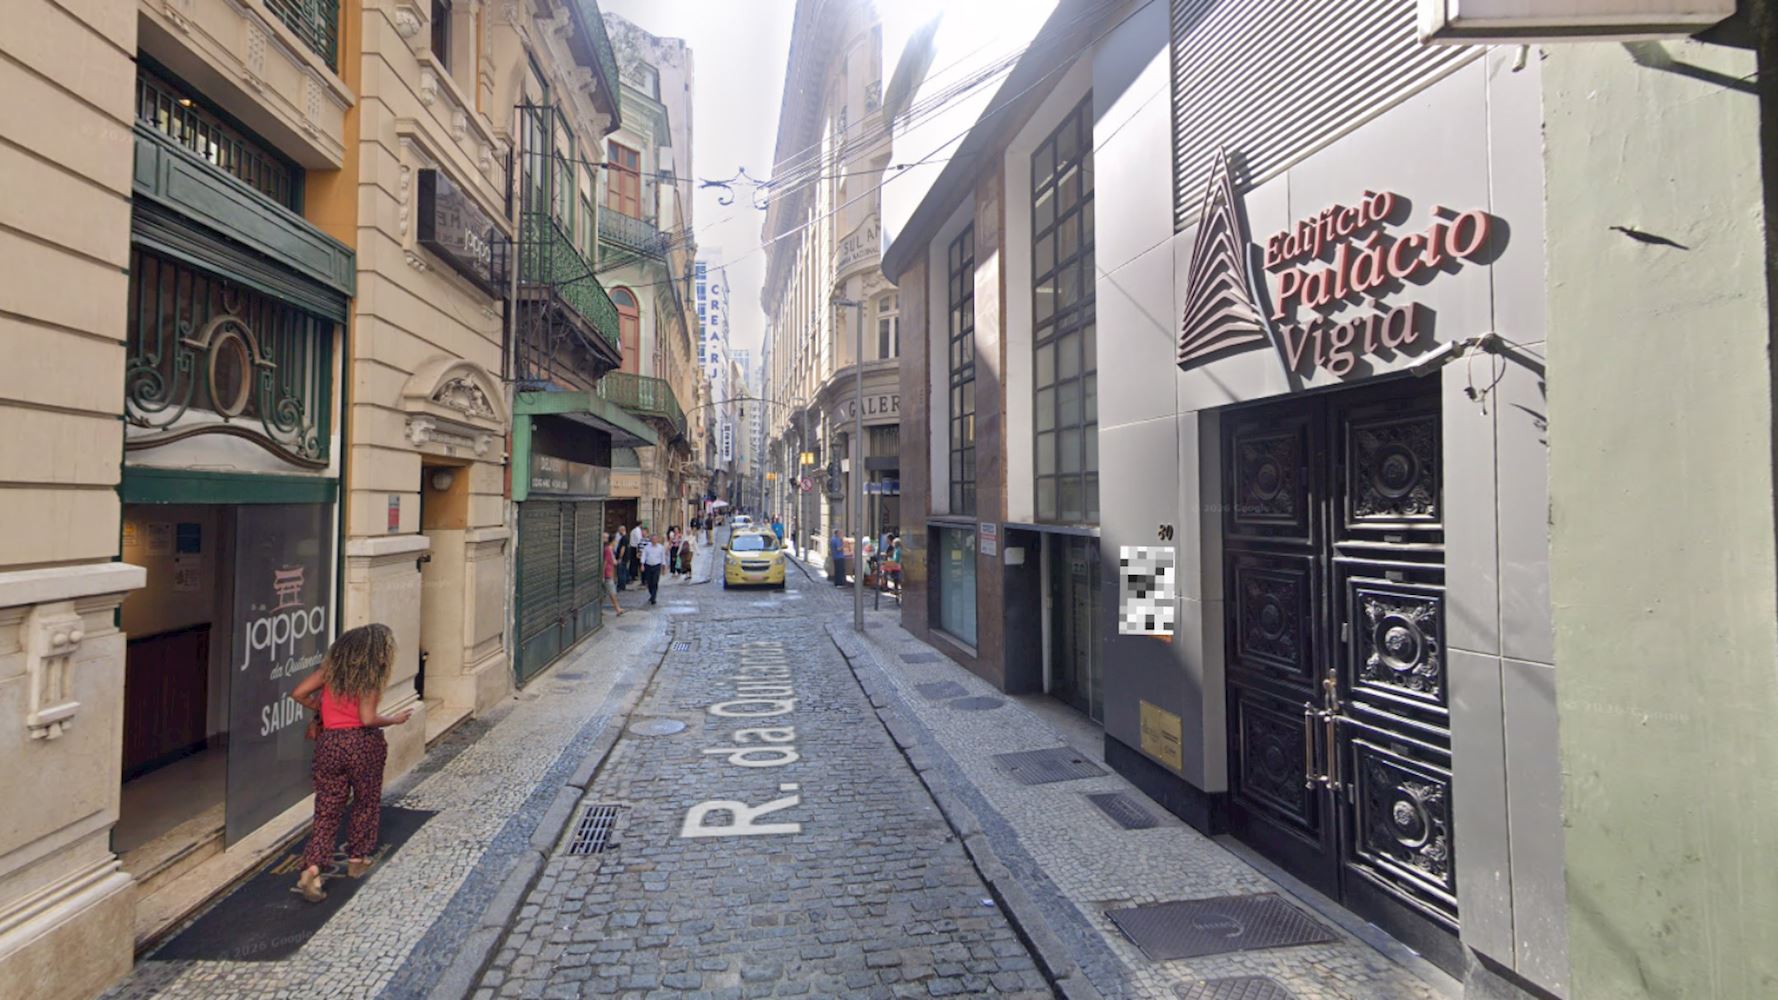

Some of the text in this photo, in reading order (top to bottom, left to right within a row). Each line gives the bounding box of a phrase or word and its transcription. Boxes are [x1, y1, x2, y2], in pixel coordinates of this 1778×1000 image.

[843, 235, 864, 256] SUL
[1263, 190, 1394, 270] Edifício
[1271, 205, 1490, 321] Palácio
[710, 284, 719, 378] CREA-RJ
[1279, 299, 1419, 376] Vigia
[240, 605, 325, 671] jappa
[285, 651, 322, 676] Quitand
[261, 692, 303, 736] SAÍDA
